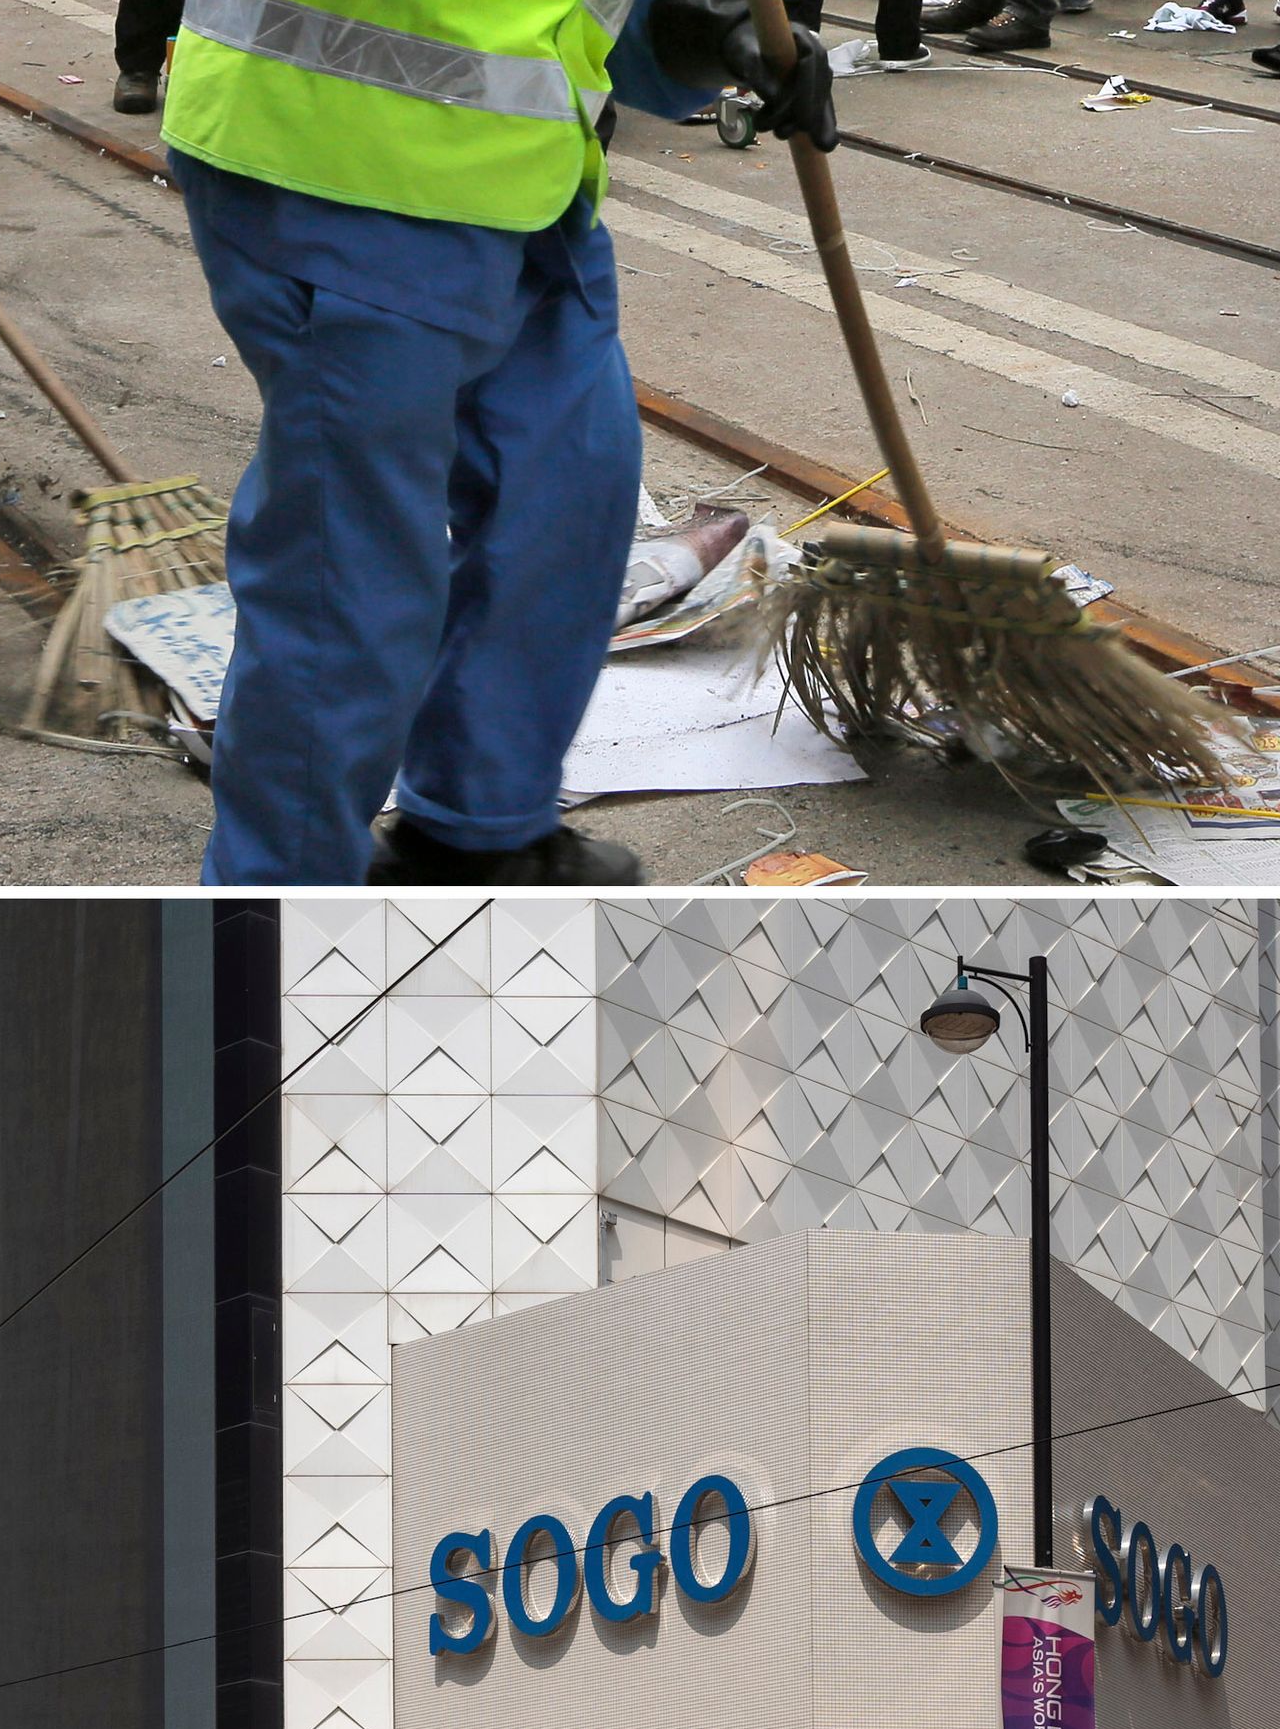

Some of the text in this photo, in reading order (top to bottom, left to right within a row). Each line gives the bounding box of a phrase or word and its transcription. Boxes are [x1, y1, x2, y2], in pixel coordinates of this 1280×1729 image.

[429, 1473, 758, 1658] SOGO
[1083, 1494, 1230, 1680] SOGO
[1031, 1635, 1045, 1695] ASIA'S
[1044, 1635, 1064, 1721] HONG
